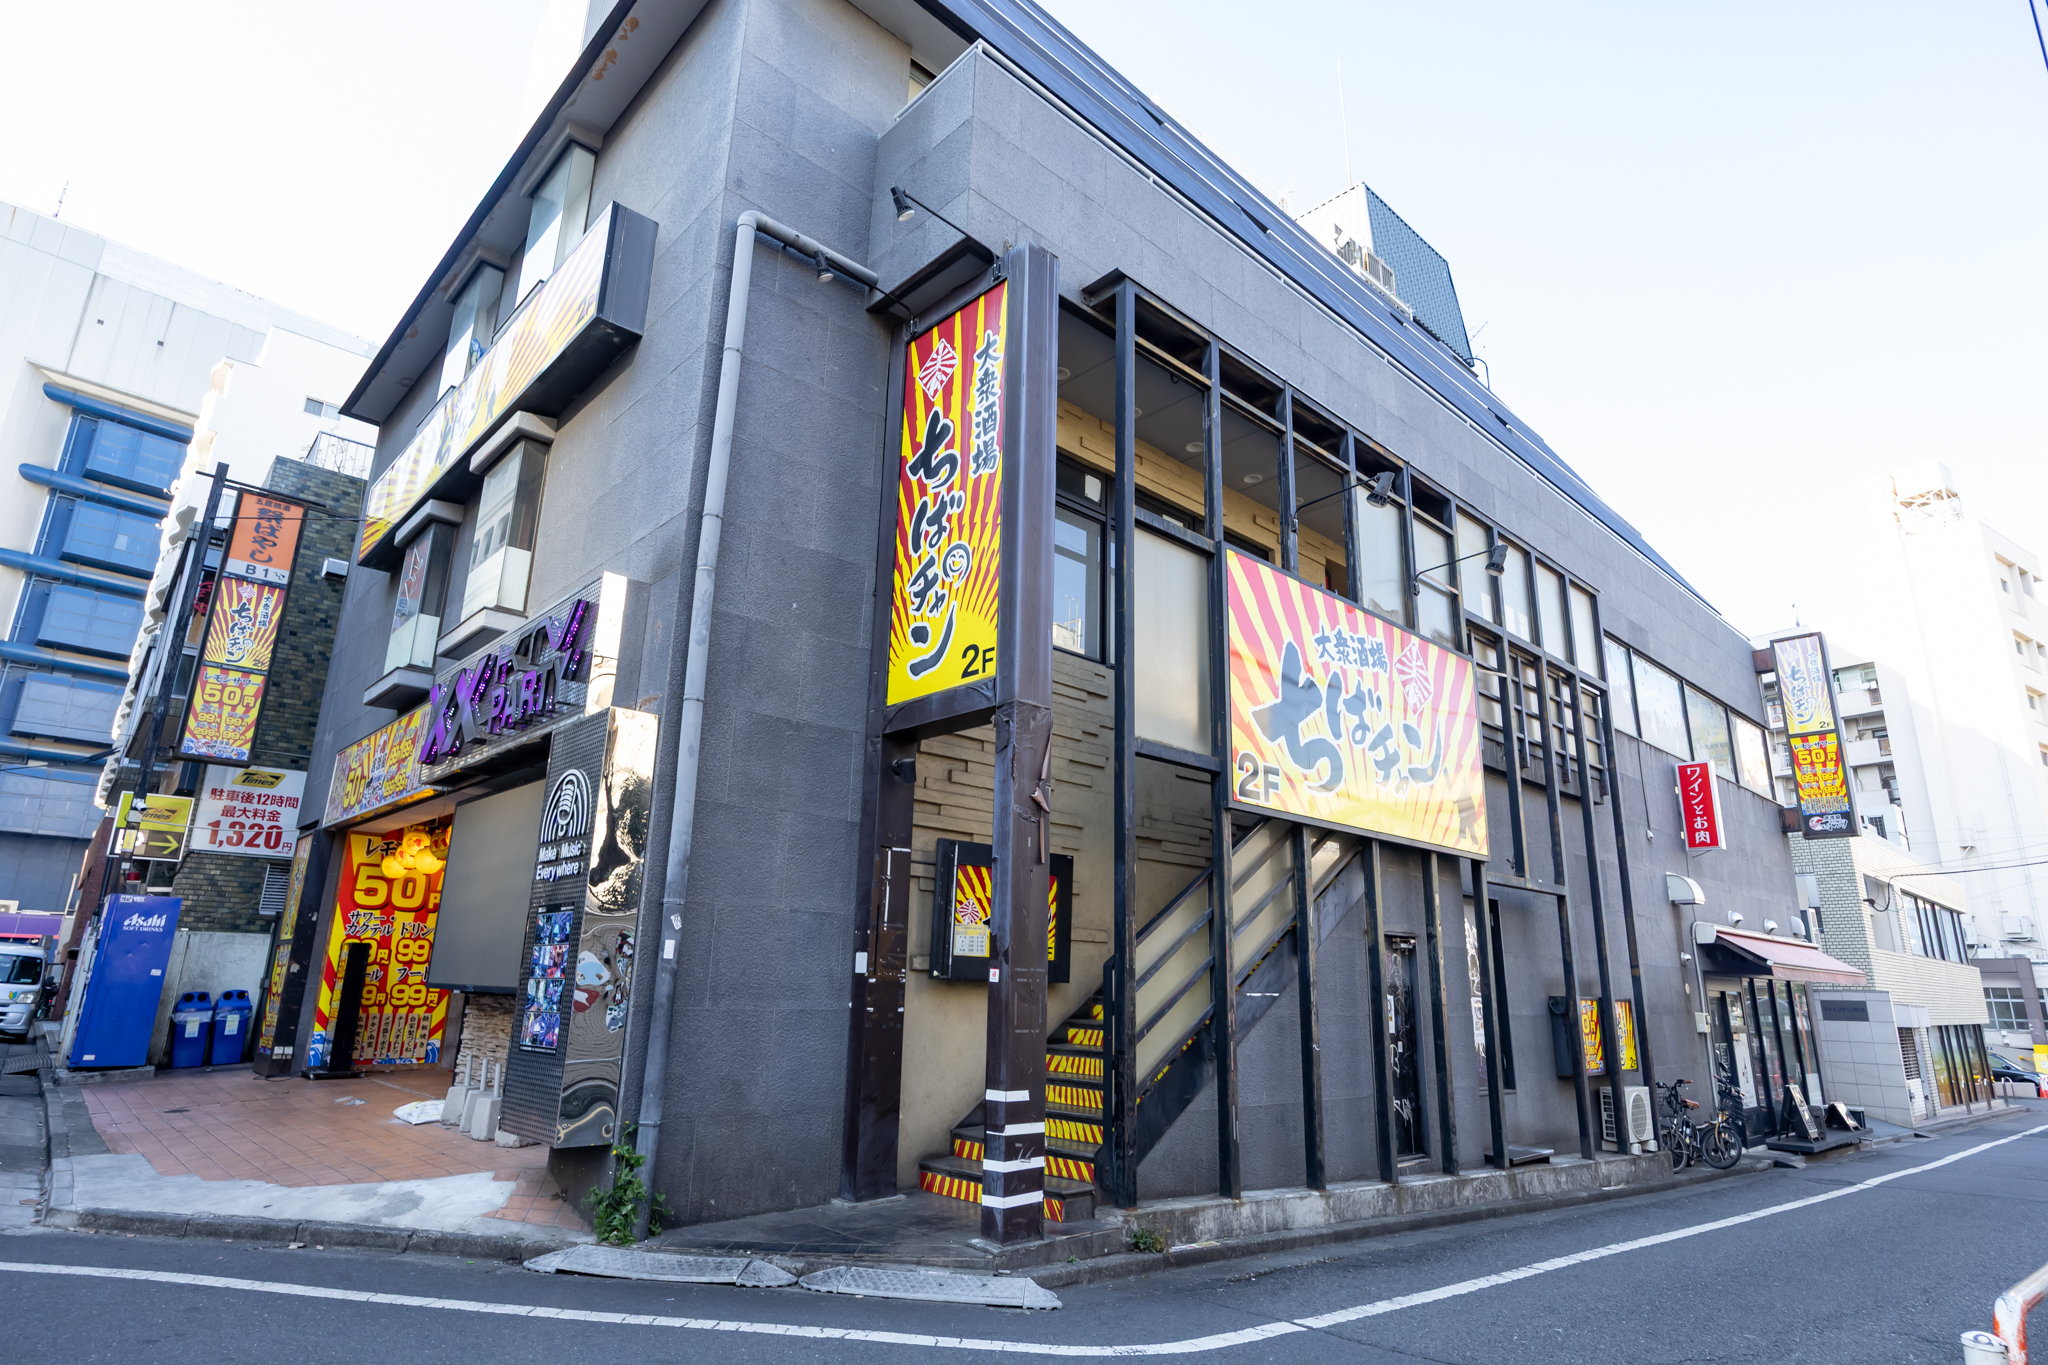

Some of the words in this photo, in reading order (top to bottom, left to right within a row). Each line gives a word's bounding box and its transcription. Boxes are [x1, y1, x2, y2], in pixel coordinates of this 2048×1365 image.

[970, 331, 1003, 477] 大衆酒場
[249, 507, 285, 564] 祭ばやし
[907, 408, 966, 678] ちばチャン
[960, 643, 996, 680] 2F
[1314, 620, 1390, 676] 大衆酒場
[202, 682, 257, 708] 50円
[203, 671, 262, 688] レモンサワー
[487, 648, 580, 734] PARTY
[1251, 639, 1443, 797] ちばチャン
[1797, 748, 1837, 765] 50円
[240, 773, 276, 788] Times
[1237, 752, 1281, 804] 2F
[142, 810, 173, 820] imes
[209, 788, 300, 809] 駐車後12時間
[220, 805, 282, 822] 最大料金
[1686, 766, 1711, 845] ワインとお肉
[538, 845, 557, 863] Make
[560, 840, 582, 859] Music
[535, 861, 579, 882] Everywhere
[123, 912, 168, 928] Asahi
[344, 923, 395, 937] カクテル
[367, 1014, 380, 1049] チキン南蛮
[378, 1015, 392, 1058] メガ盛りポテト
[391, 1014, 405, 1057] チーズオムレツ
[404, 1015, 418, 1054] 自家製つくね
[417, 1014, 430, 1049] 鉄板焼き
